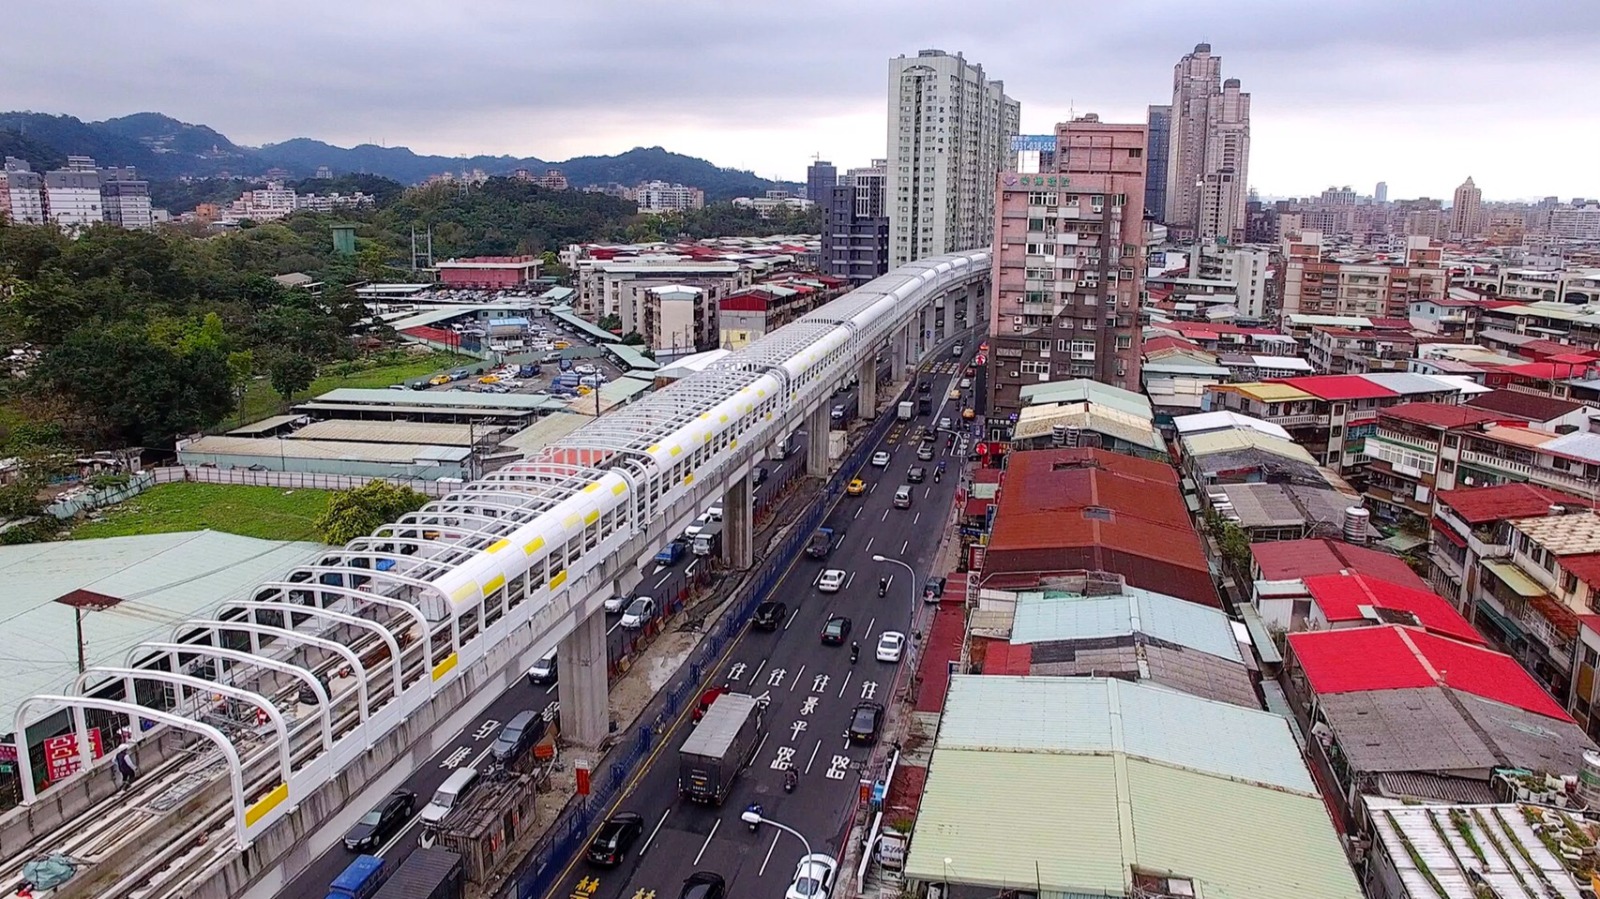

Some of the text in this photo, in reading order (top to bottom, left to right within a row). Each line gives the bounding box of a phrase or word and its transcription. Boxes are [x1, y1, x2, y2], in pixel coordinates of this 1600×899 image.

[727, 662, 747, 680] 往
[770, 674, 830, 771] 往景平路
